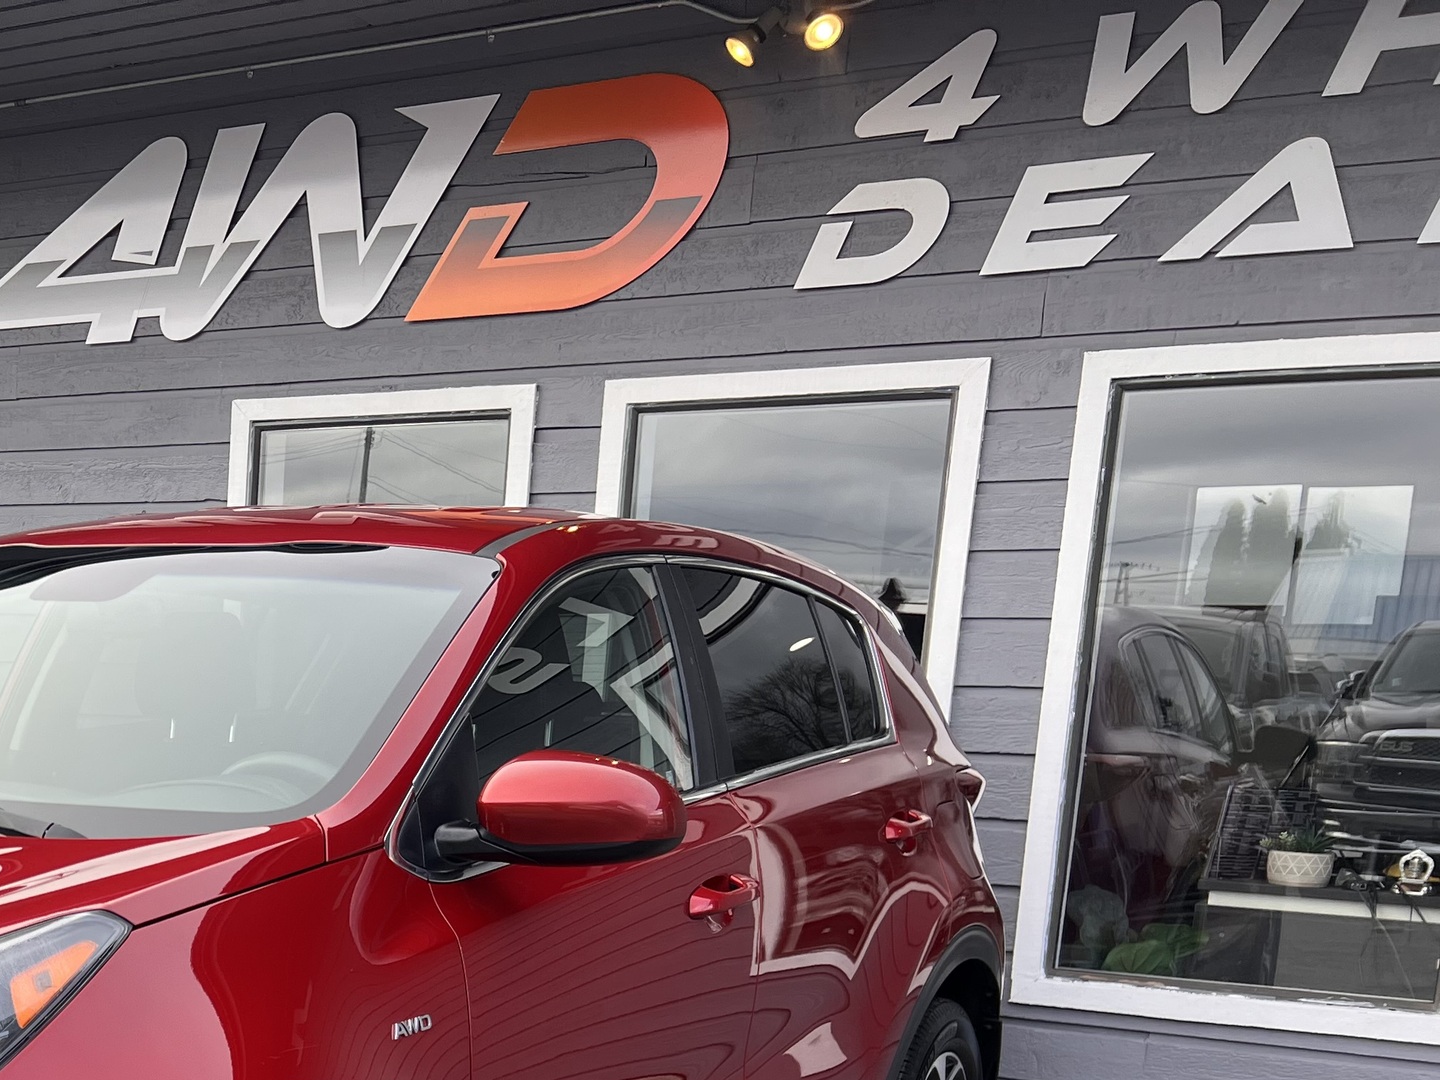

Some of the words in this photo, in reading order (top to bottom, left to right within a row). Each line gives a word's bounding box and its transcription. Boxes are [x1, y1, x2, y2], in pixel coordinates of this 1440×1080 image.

[854, 28, 1000, 142] 4
[794, 136, 1440, 289] DEA
[394, 1014, 432, 1040] AWD
